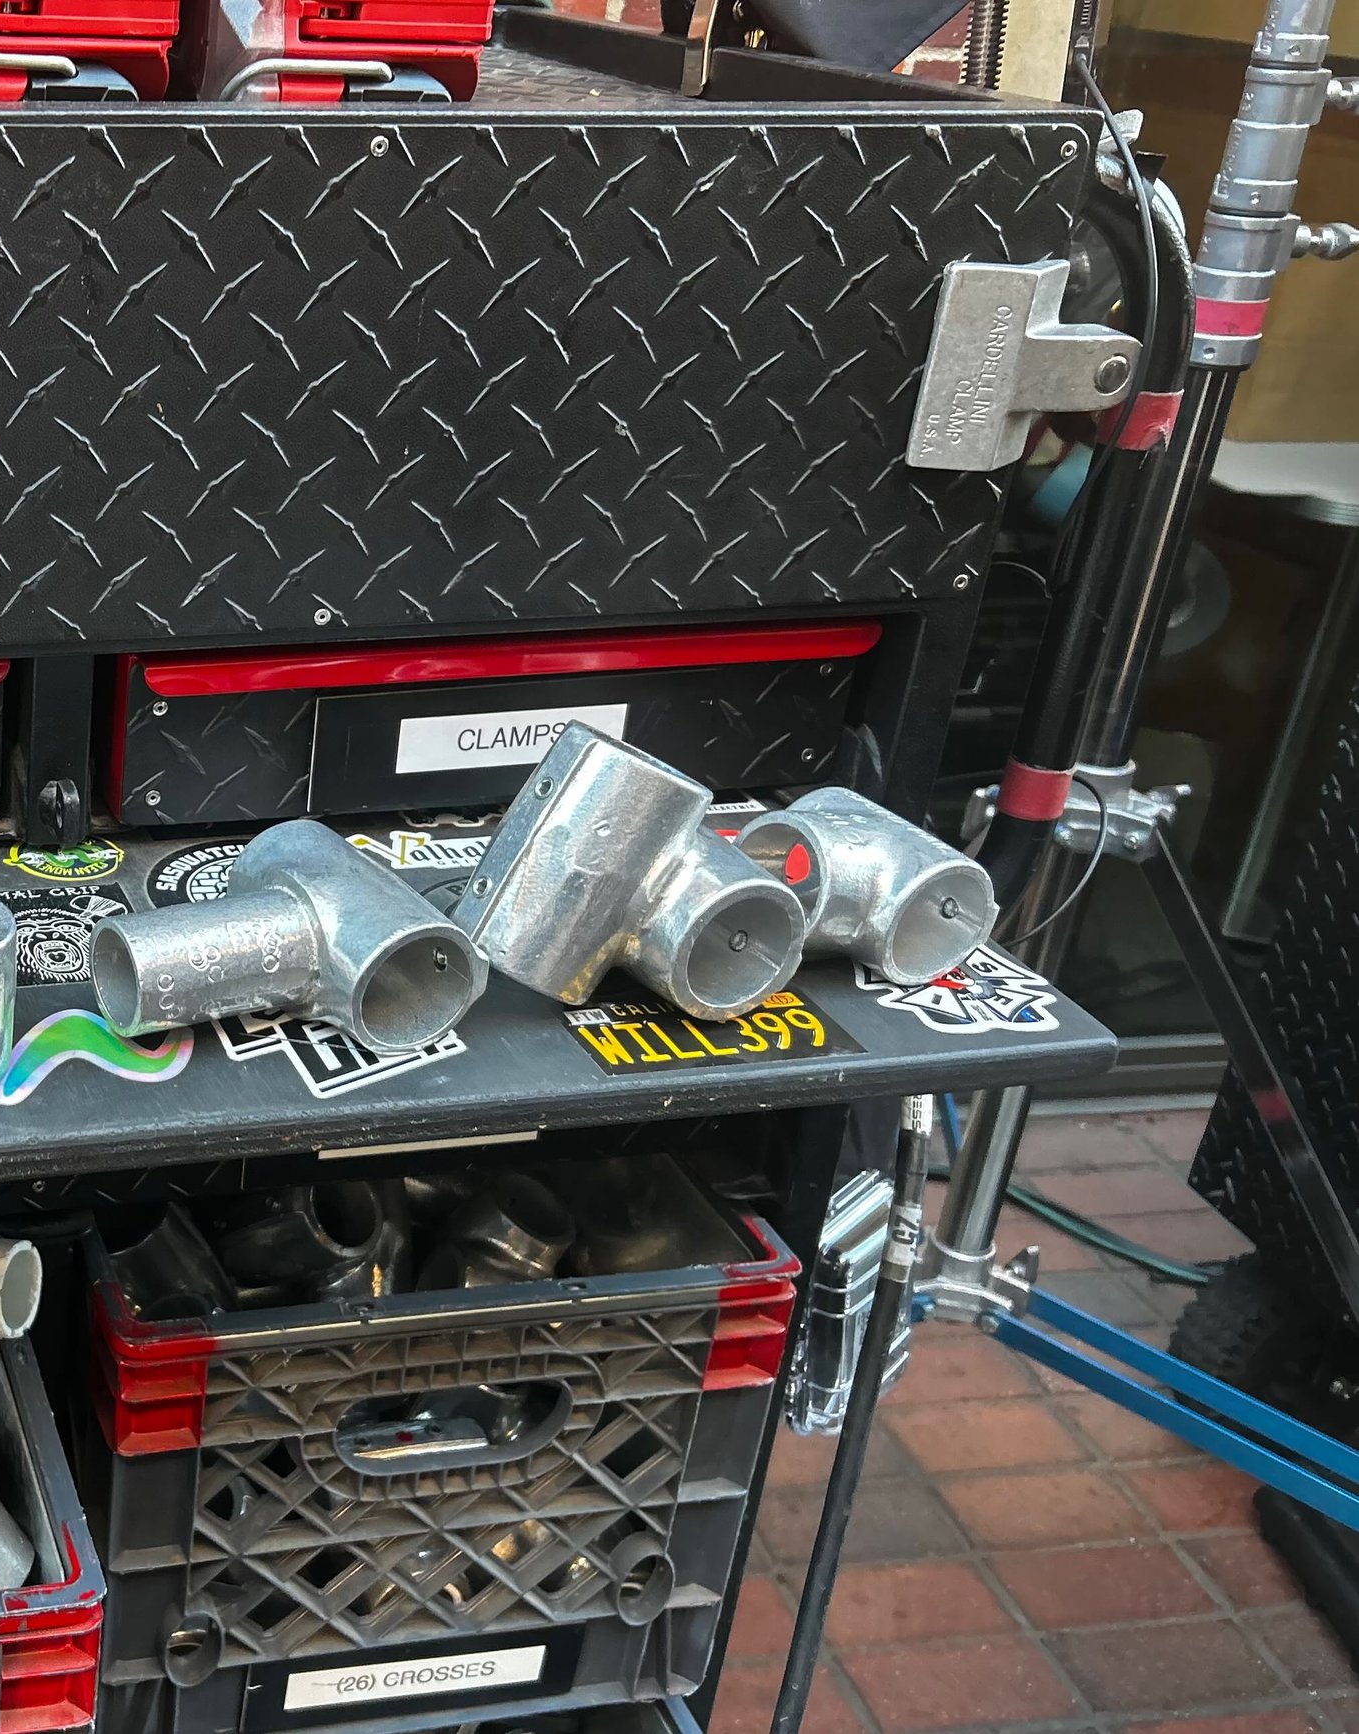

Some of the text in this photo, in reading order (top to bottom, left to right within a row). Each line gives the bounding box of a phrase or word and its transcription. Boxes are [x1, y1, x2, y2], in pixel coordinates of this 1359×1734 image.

[968, 304, 1014, 425] CARDELLINI
[919, 413, 941, 458] U.S.A.
[945, 379, 972, 447] CLAMP
[457, 722, 567, 751] CLAMPS
[49, 885, 101, 897] GRIP
[577, 1007, 826, 1066] WILL399
[336, 1660, 497, 1694] (26) CROSSES
